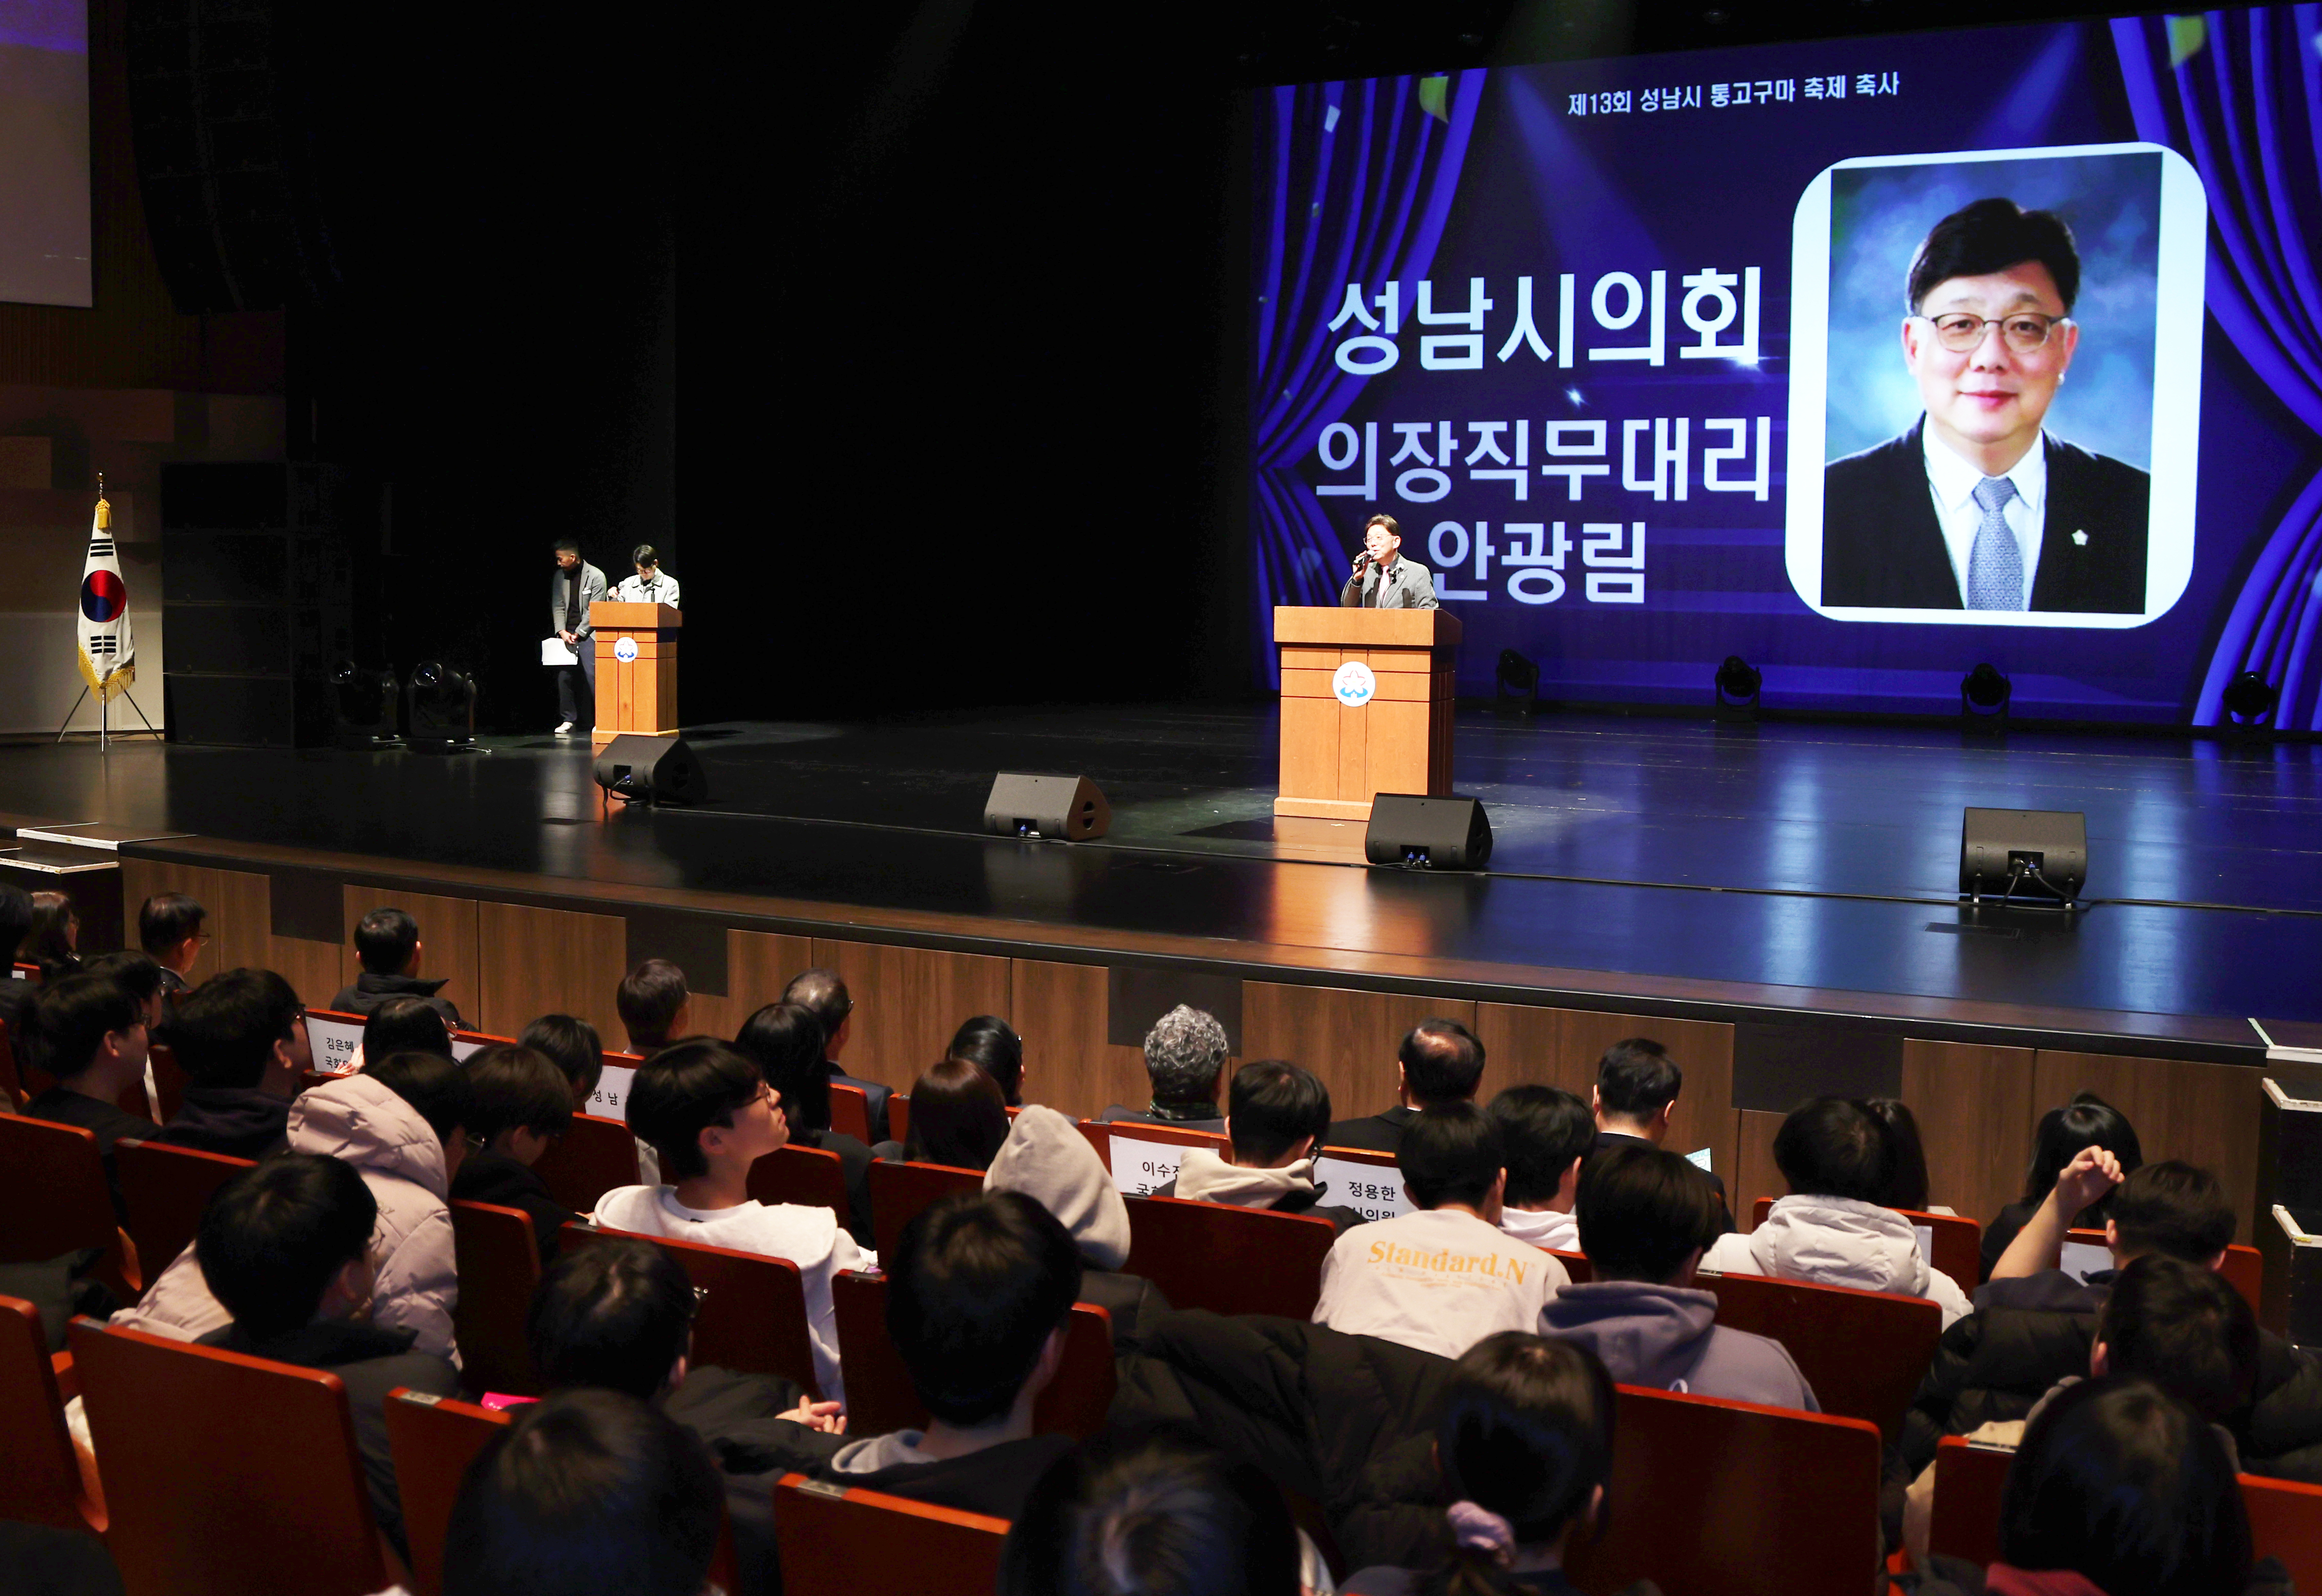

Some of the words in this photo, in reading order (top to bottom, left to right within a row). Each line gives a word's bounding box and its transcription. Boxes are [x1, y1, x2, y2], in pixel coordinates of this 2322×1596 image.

[1567, 90, 1631, 116] 제13회
[1639, 85, 1701, 112] 성남시
[1710, 78, 1796, 108] 통고구마
[1804, 75, 1846, 101] 축제
[1855, 71, 1900, 97] 축사
[1327, 266, 1761, 375] 성남시의회
[1316, 416, 1771, 503] 의장직무대리
[1428, 520, 1646, 604] 안광림
[326, 1037, 354, 1052] 김은혜
[1349, 1181, 1395, 1201] 정용한
[1367, 1241, 1528, 1285] Standard.N
